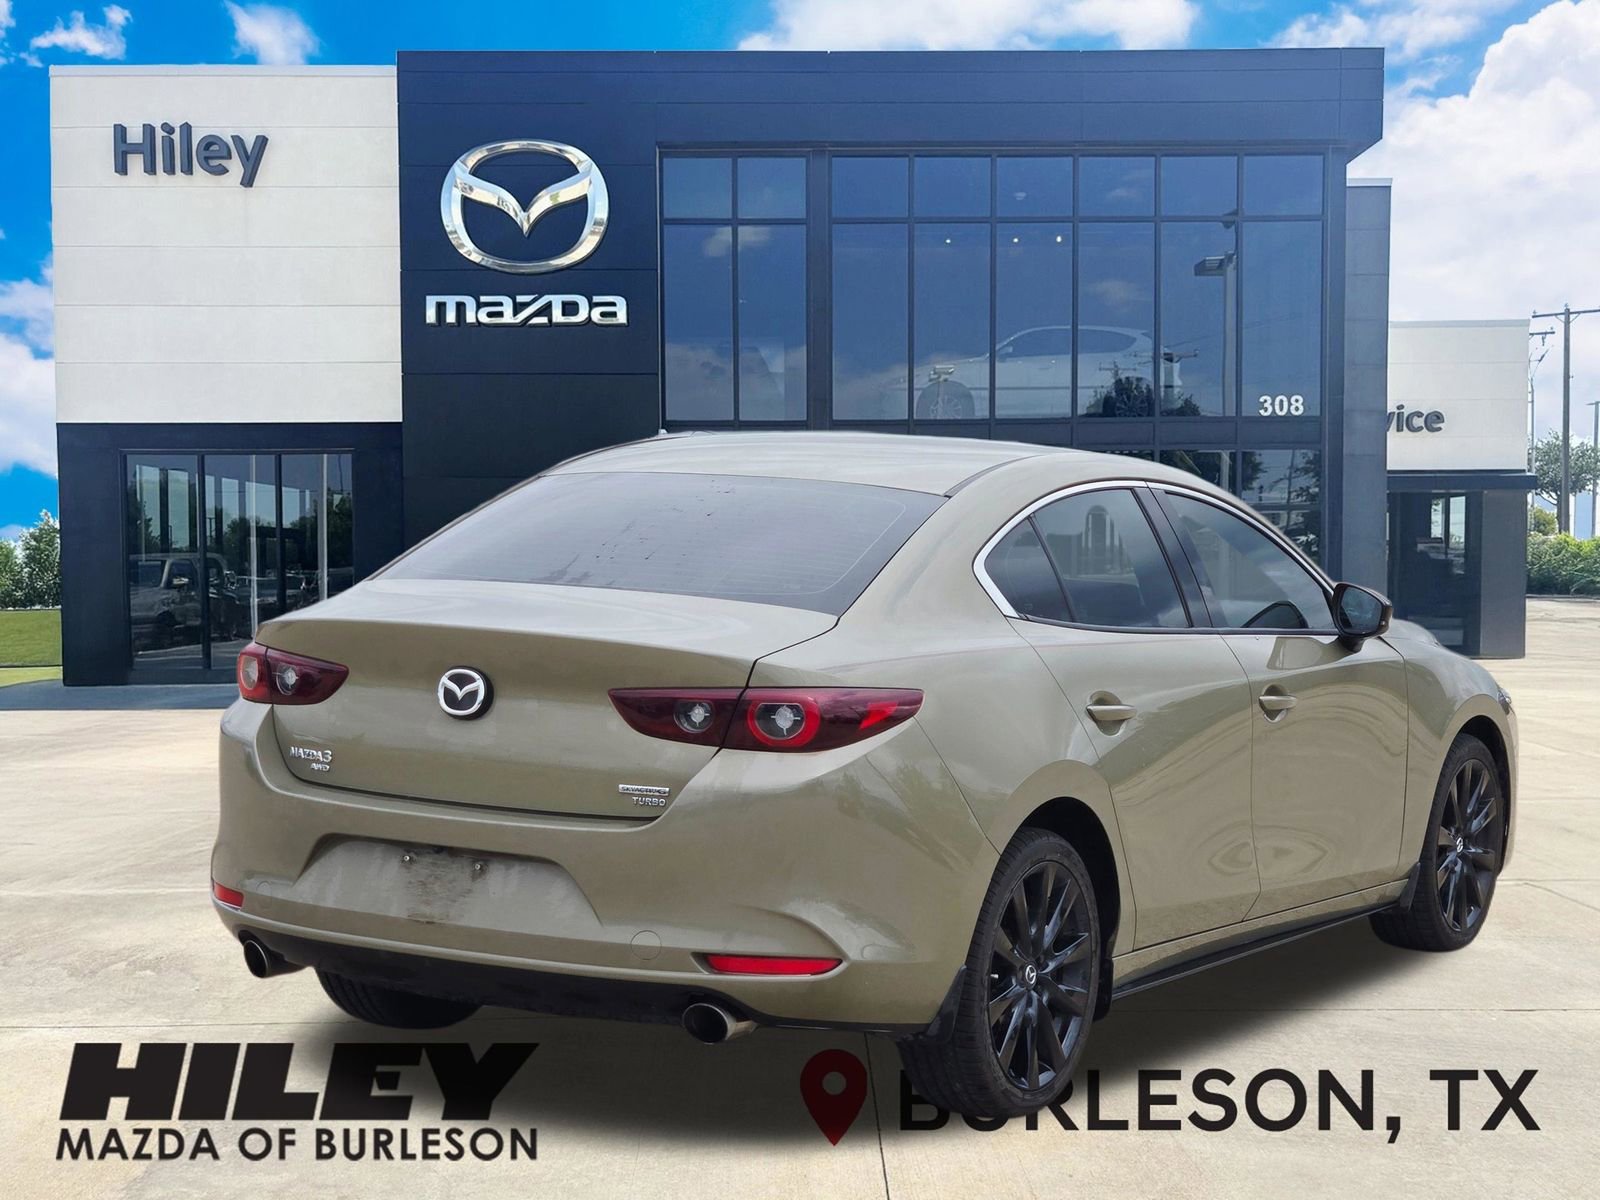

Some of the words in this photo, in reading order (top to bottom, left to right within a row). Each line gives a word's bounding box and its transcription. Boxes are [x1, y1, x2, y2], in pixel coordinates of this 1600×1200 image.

[113, 121, 269, 189] Hiley
[1258, 394, 1305, 417] 308
[632, 796, 666, 807] TURBO
